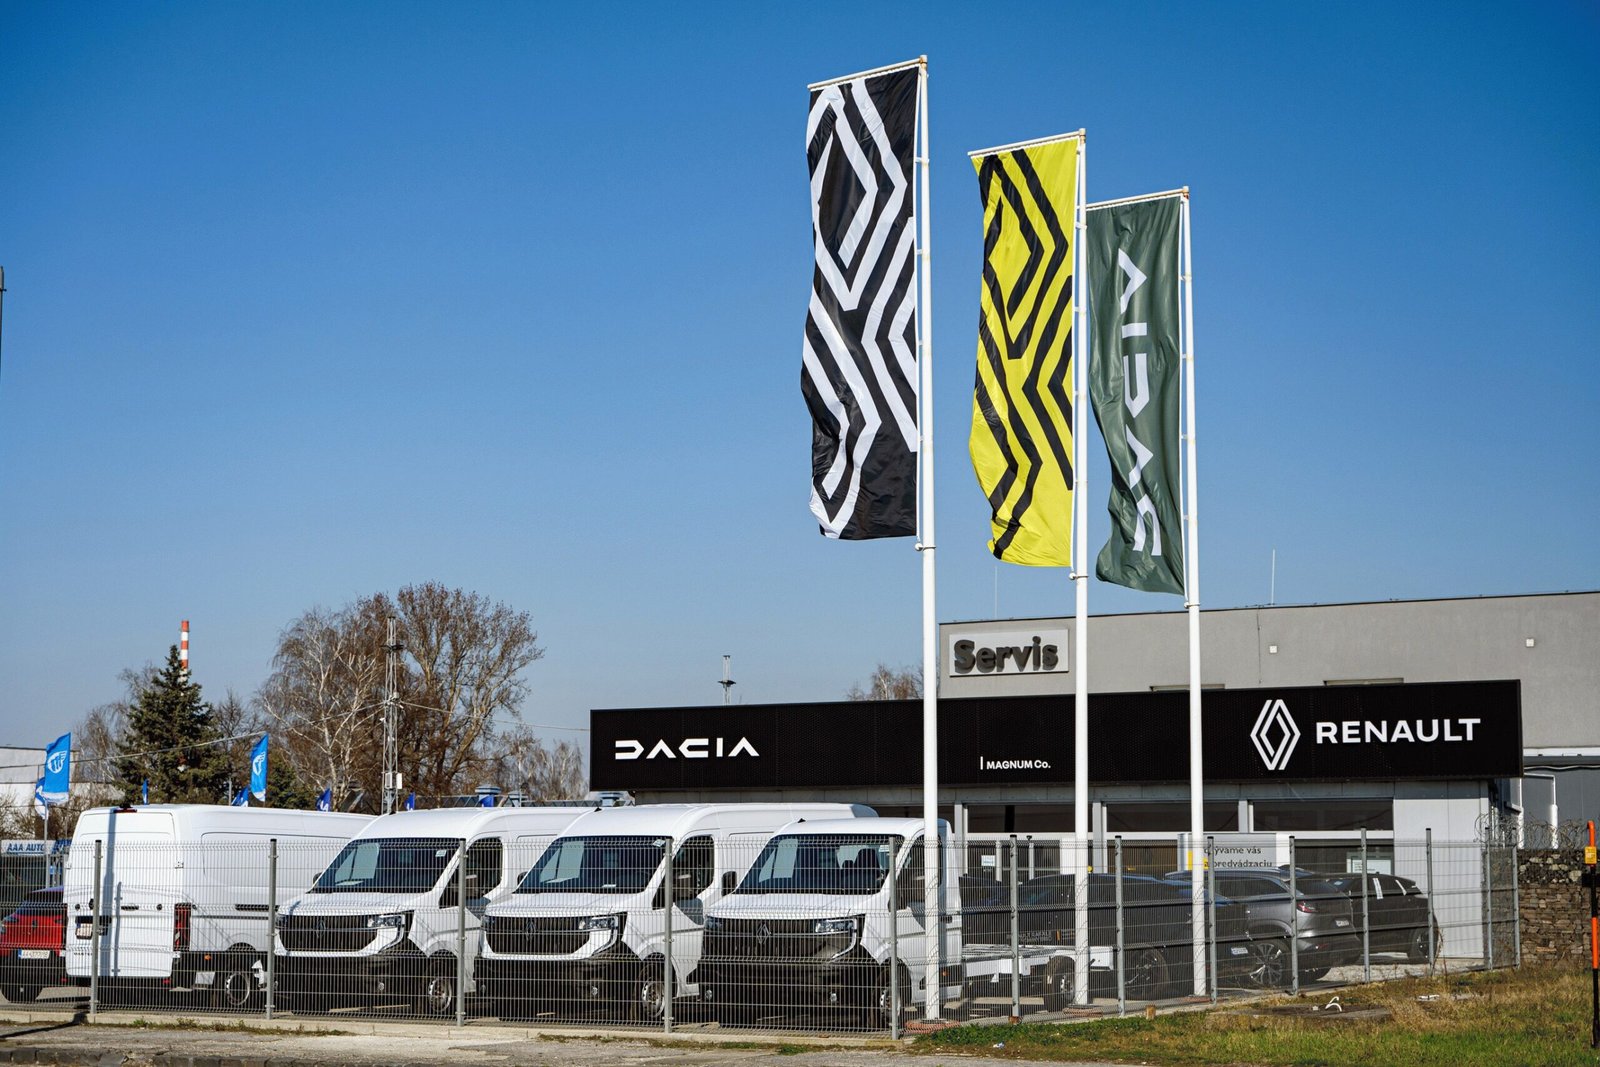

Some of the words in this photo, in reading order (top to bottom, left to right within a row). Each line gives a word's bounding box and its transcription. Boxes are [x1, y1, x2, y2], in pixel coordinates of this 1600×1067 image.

[954, 636, 1059, 674] Servis
[1316, 718, 1481, 744] RENAULT
[614, 736, 760, 760] DACIA
[986, 760, 1033, 770] MAGNUM
[1034, 759, 1051, 769] Co.
[7, 843, 24, 851] AAA
[1246, 846, 1262, 854] vás
